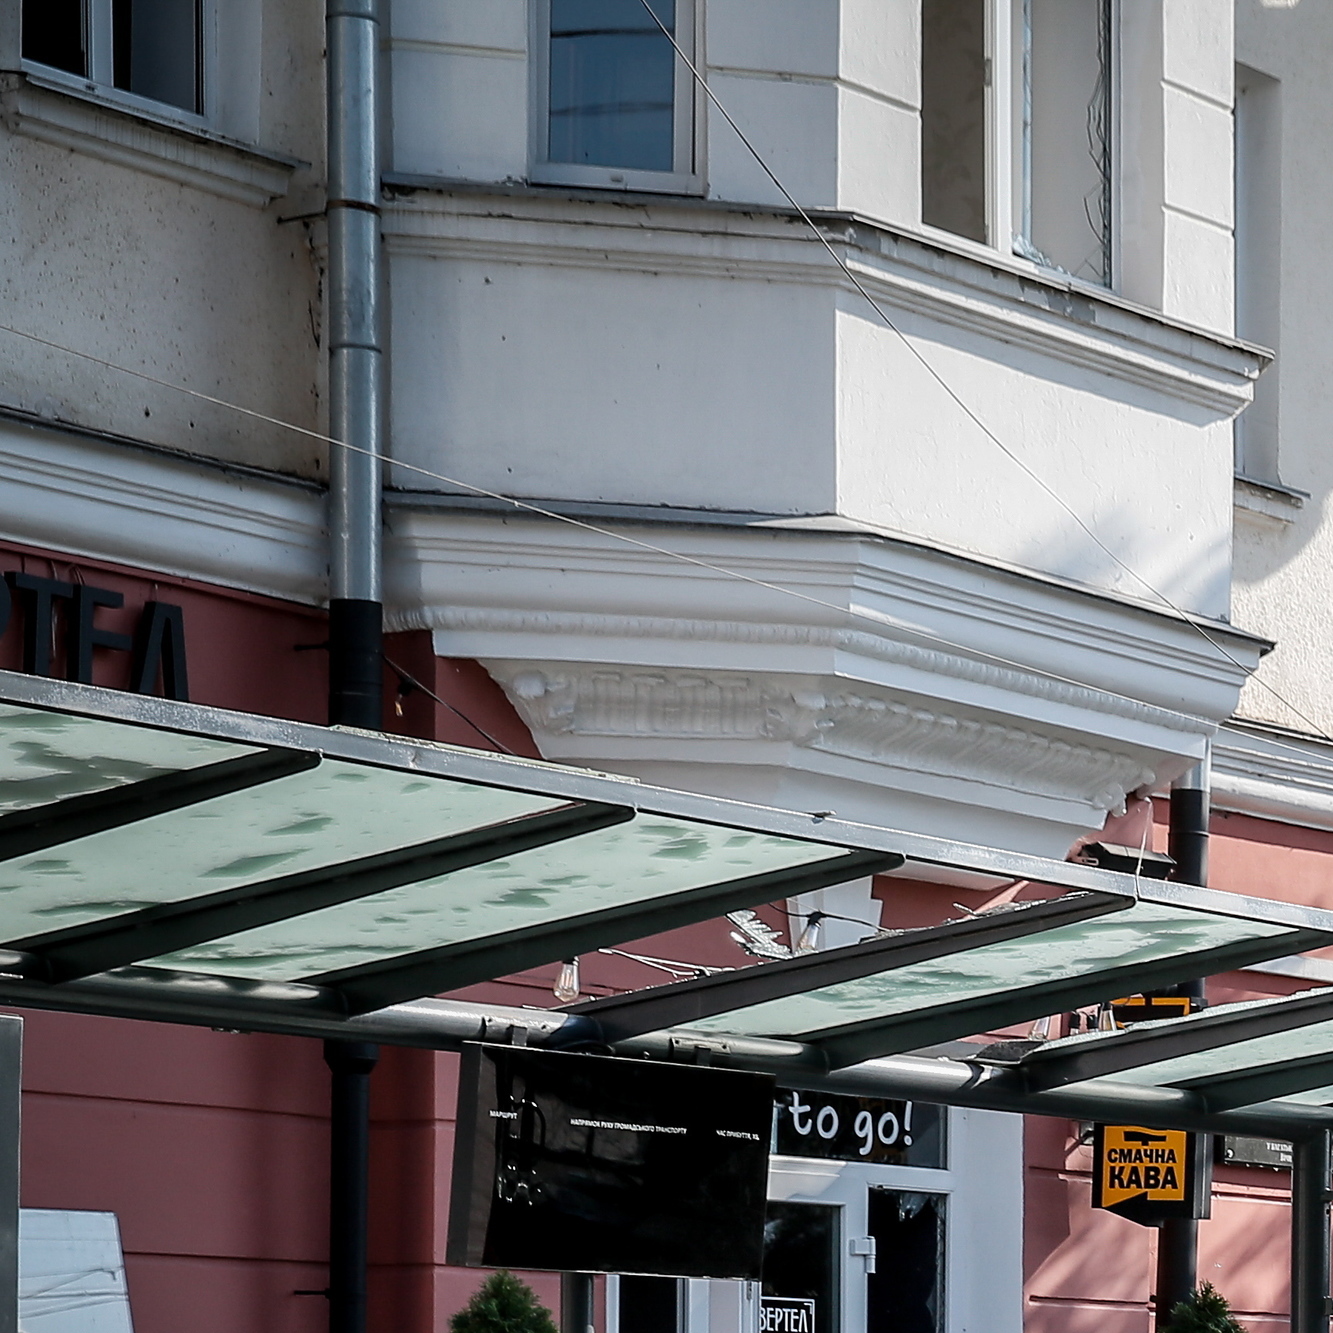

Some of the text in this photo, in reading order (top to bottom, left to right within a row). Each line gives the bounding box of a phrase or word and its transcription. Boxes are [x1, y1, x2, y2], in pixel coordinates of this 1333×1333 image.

[788, 1091, 912, 1156] to go!
[1107, 1148, 1177, 1164] СМАЧНА
[1109, 1166, 1178, 1190] КАВА
